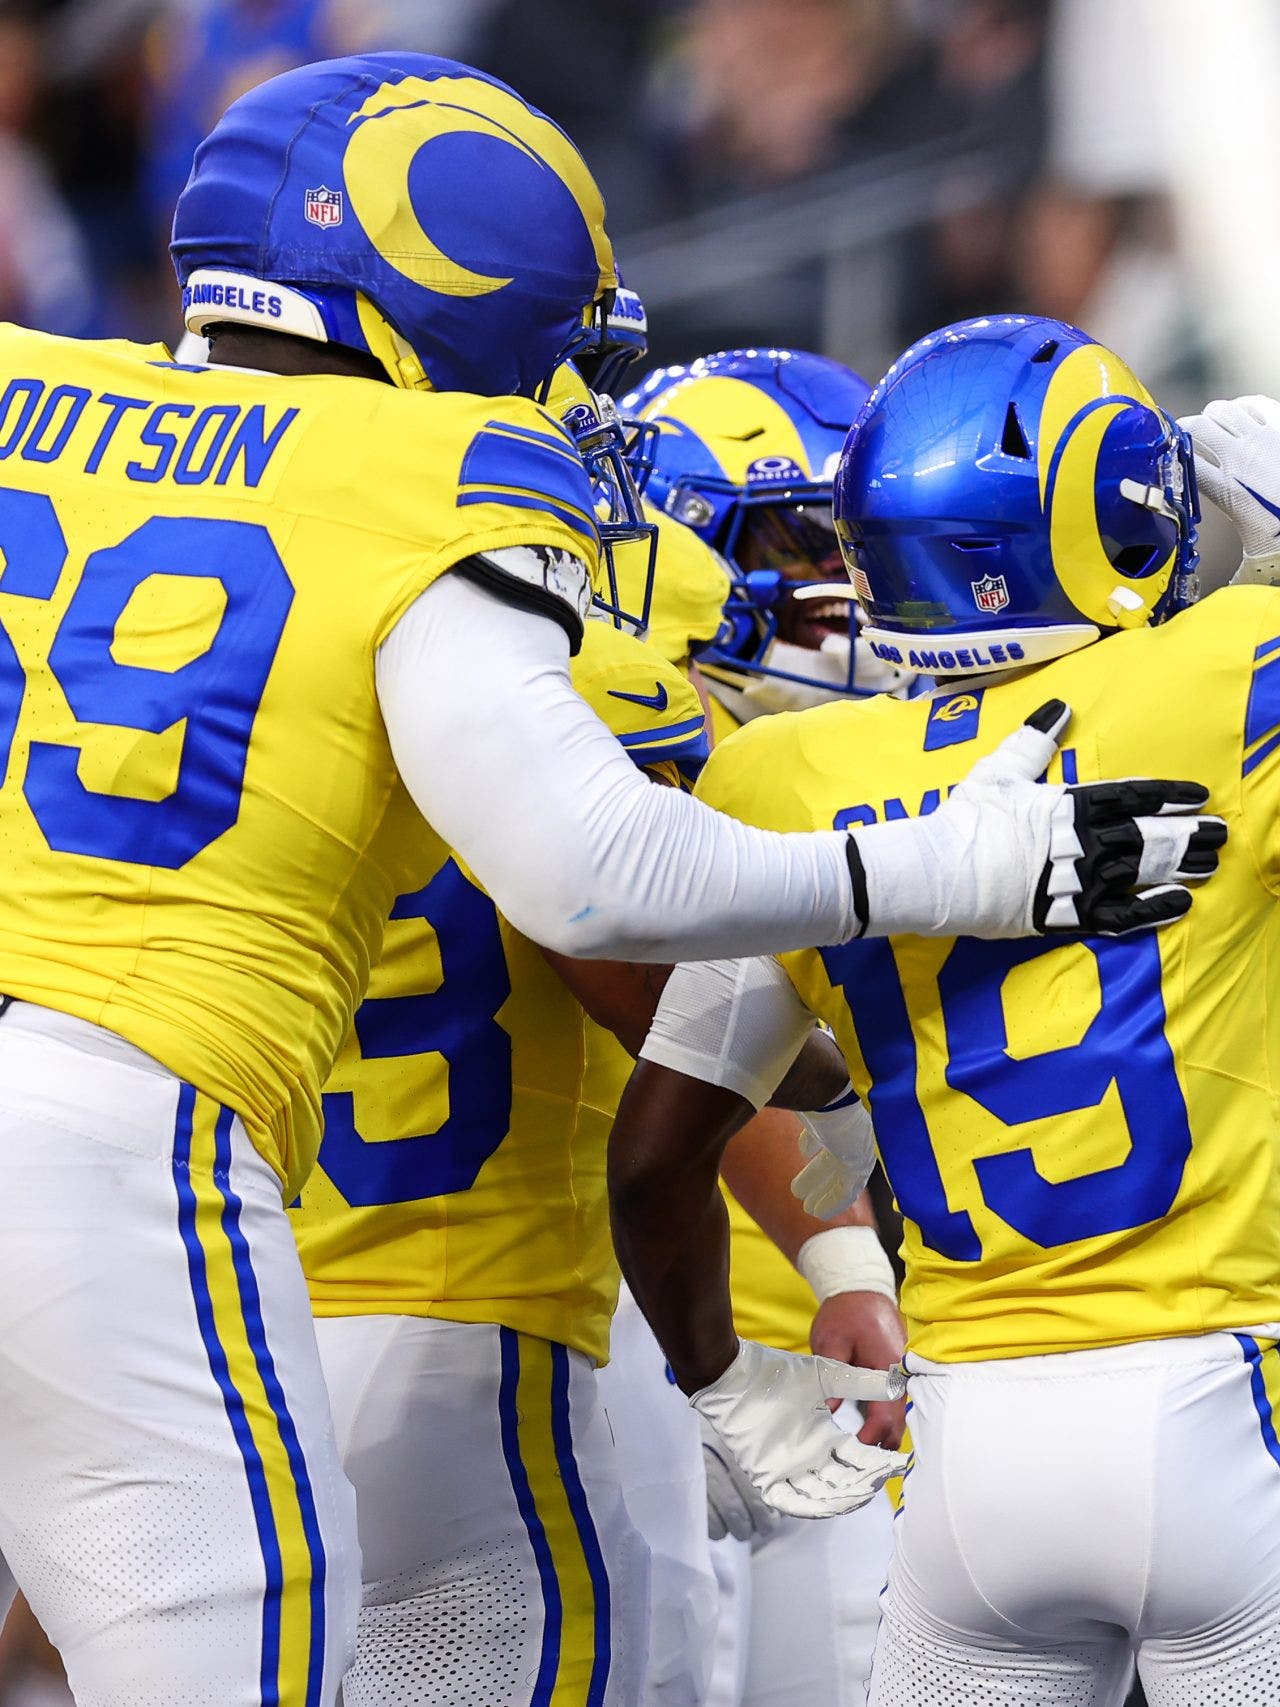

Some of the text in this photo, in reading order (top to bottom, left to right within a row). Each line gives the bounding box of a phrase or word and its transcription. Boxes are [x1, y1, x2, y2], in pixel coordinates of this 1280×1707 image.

[309, 203, 338, 222] NFL
[193, 283, 282, 318] ANGELES
[0, 378, 301, 488] DOTSON
[979, 591, 1005, 608] NFL
[870, 640, 1025, 669] LOS ANGELES
[285, 855, 513, 1209] 3
[818, 927, 1193, 1262] 19
